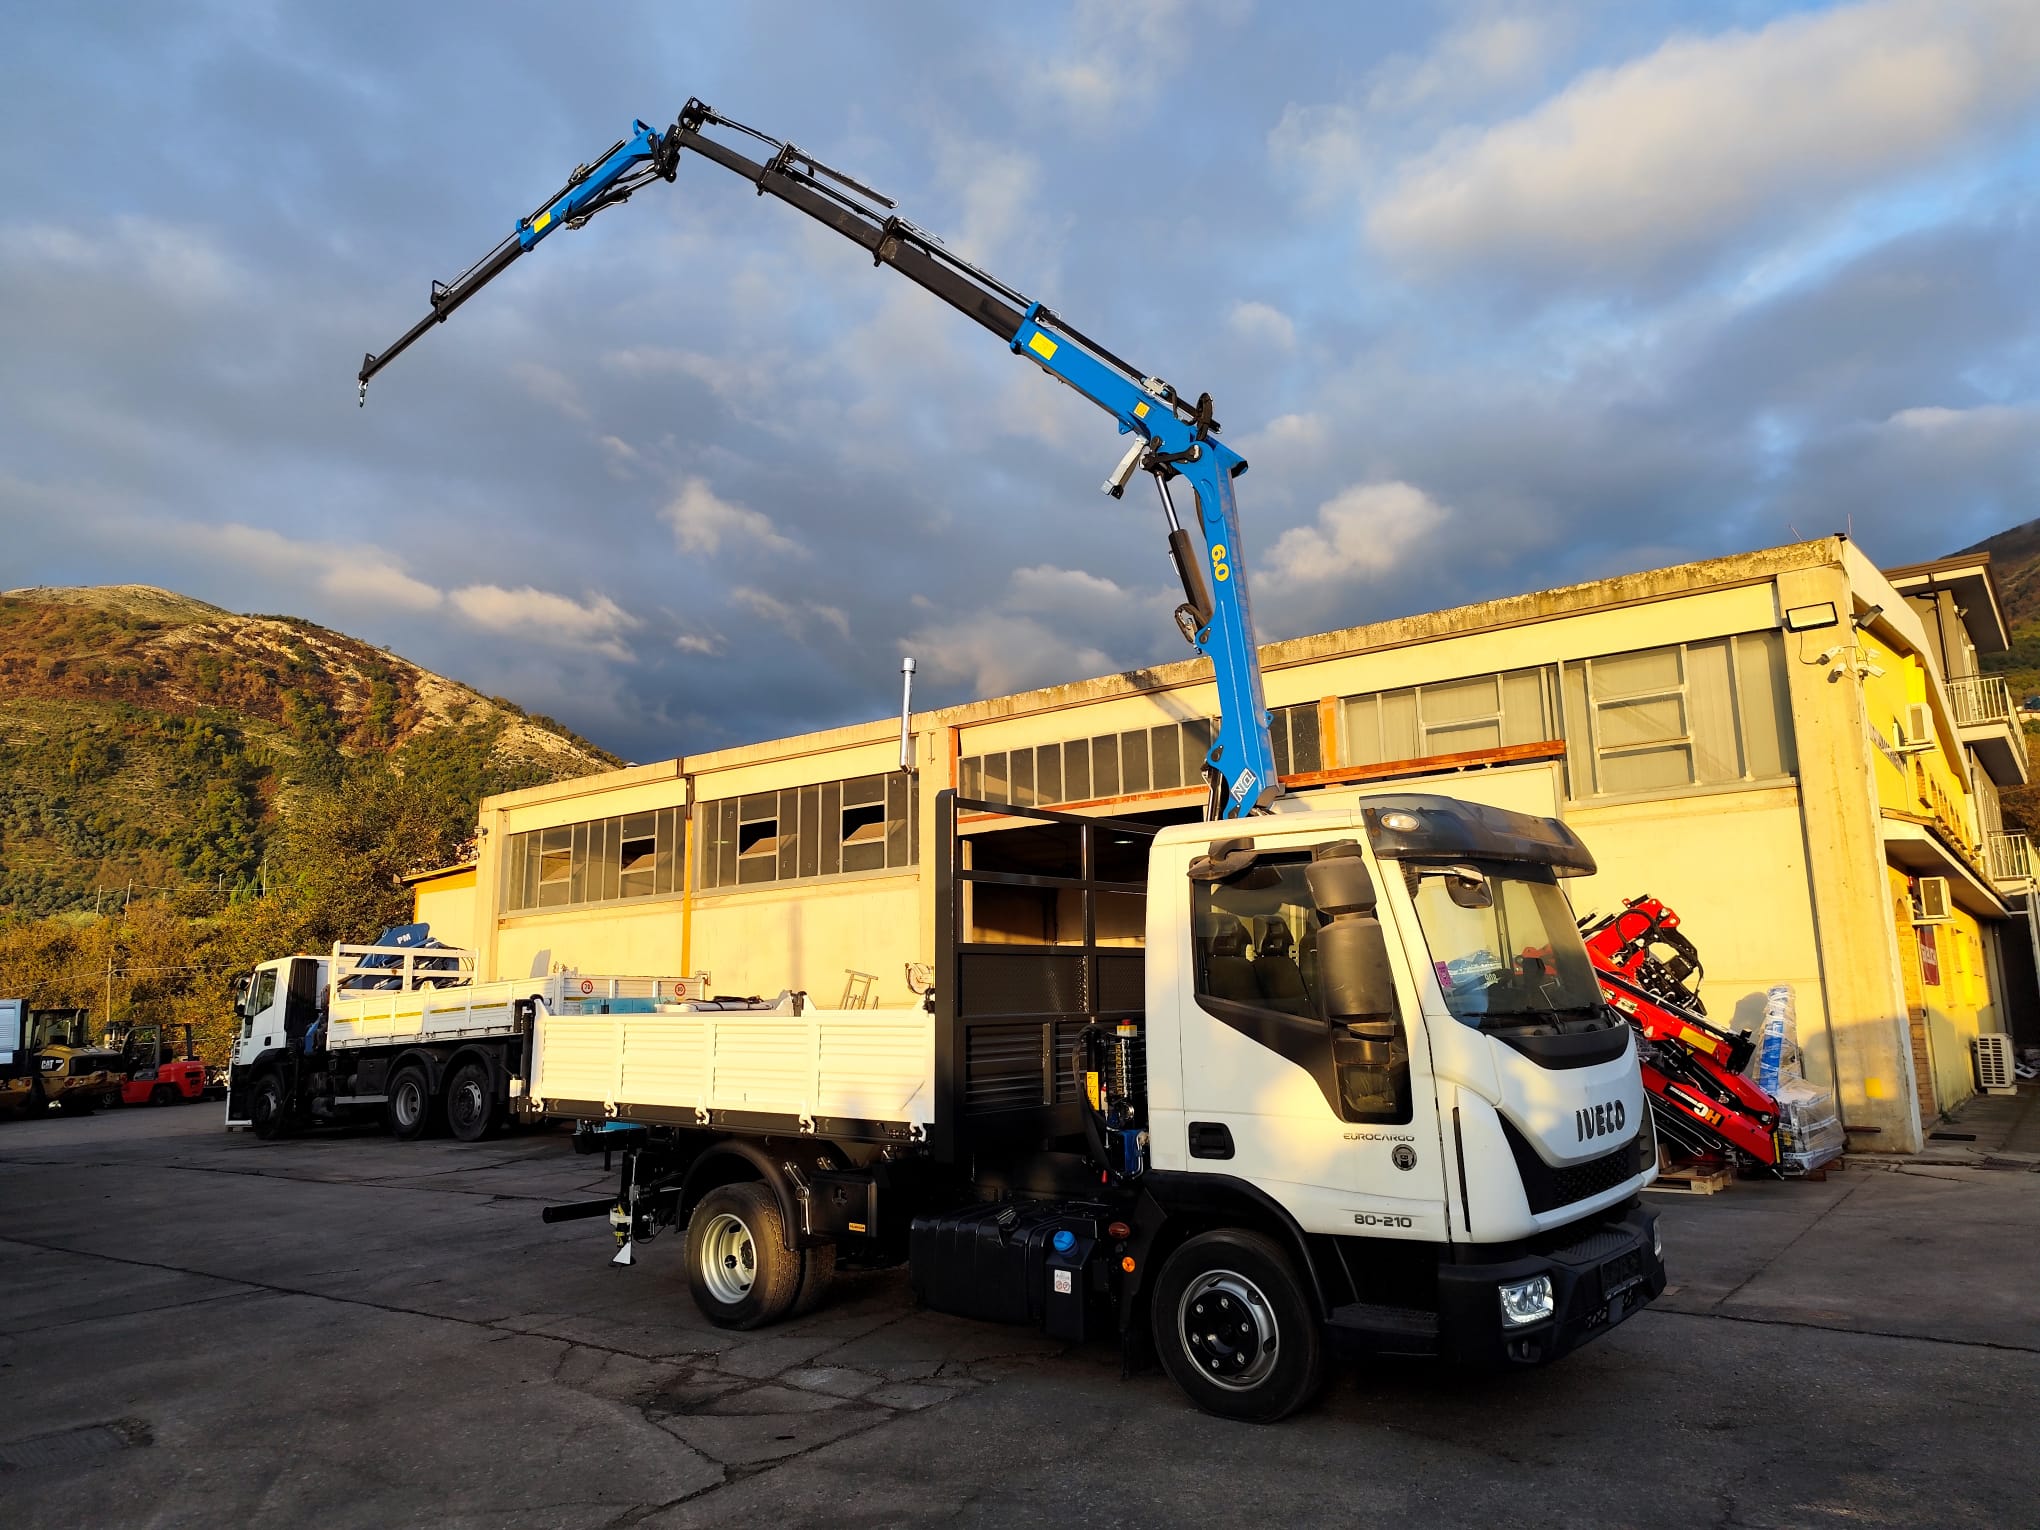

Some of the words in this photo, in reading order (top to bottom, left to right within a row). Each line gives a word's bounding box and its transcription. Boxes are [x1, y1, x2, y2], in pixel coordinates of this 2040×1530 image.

[396, 932, 412, 945] PM
[41, 1060, 55, 1070] CAT
[1576, 1099, 1625, 1142] IVECO
[1343, 1132, 1416, 1142] EUROCARGO
[1354, 1213, 1412, 1228] 80-210
